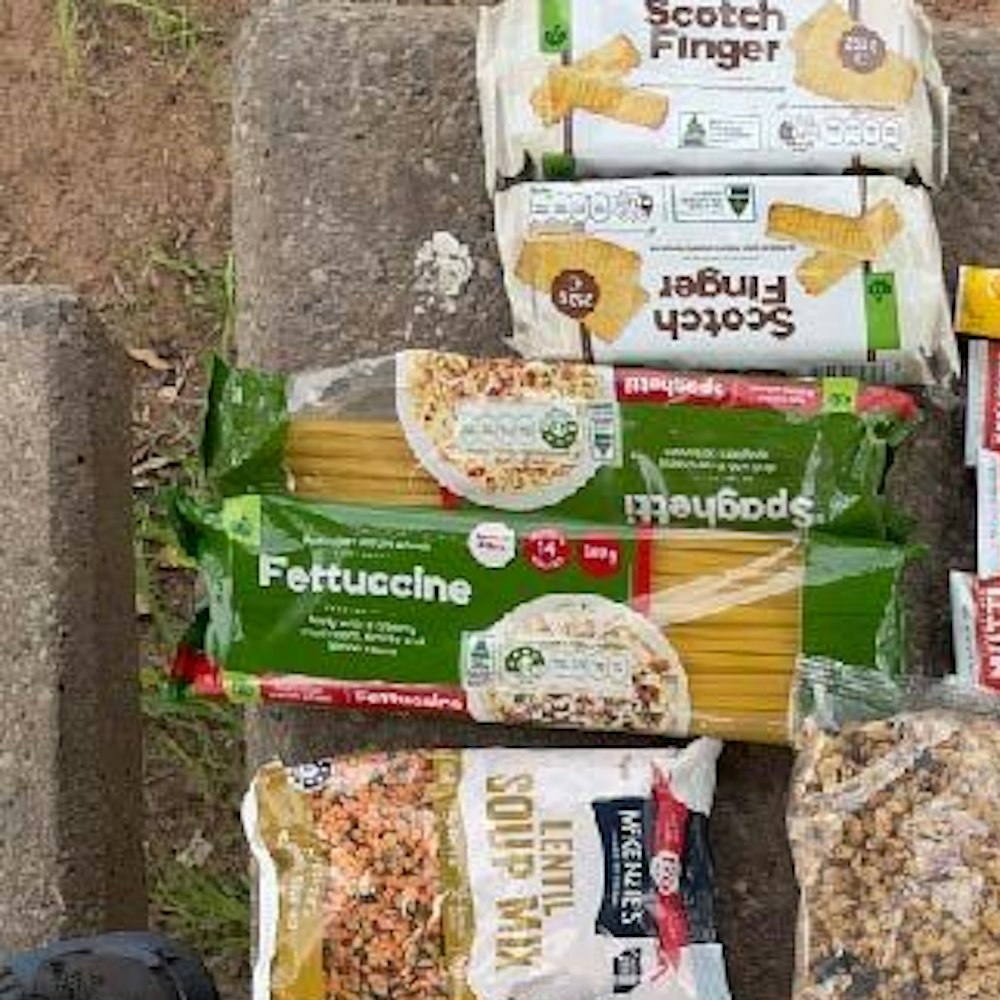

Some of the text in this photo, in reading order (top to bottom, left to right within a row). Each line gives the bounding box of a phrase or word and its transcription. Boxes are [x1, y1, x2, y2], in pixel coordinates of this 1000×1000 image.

[645, 0, 785, 31] Scotch
[650, 33, 782, 70] Finger
[660, 267, 787, 304] Finger
[654, 305, 796, 339] Scotch
[622, 374, 725, 400] Spaghetti
[623, 488, 814, 530] Spaghetti
[257, 553, 473, 606] Fettuccine
[354, 690, 464, 712] Fettuccine
[486, 773, 538, 881] SOUP
[539, 819, 576, 918] LENTIL
[493, 896, 543, 973] MIX
